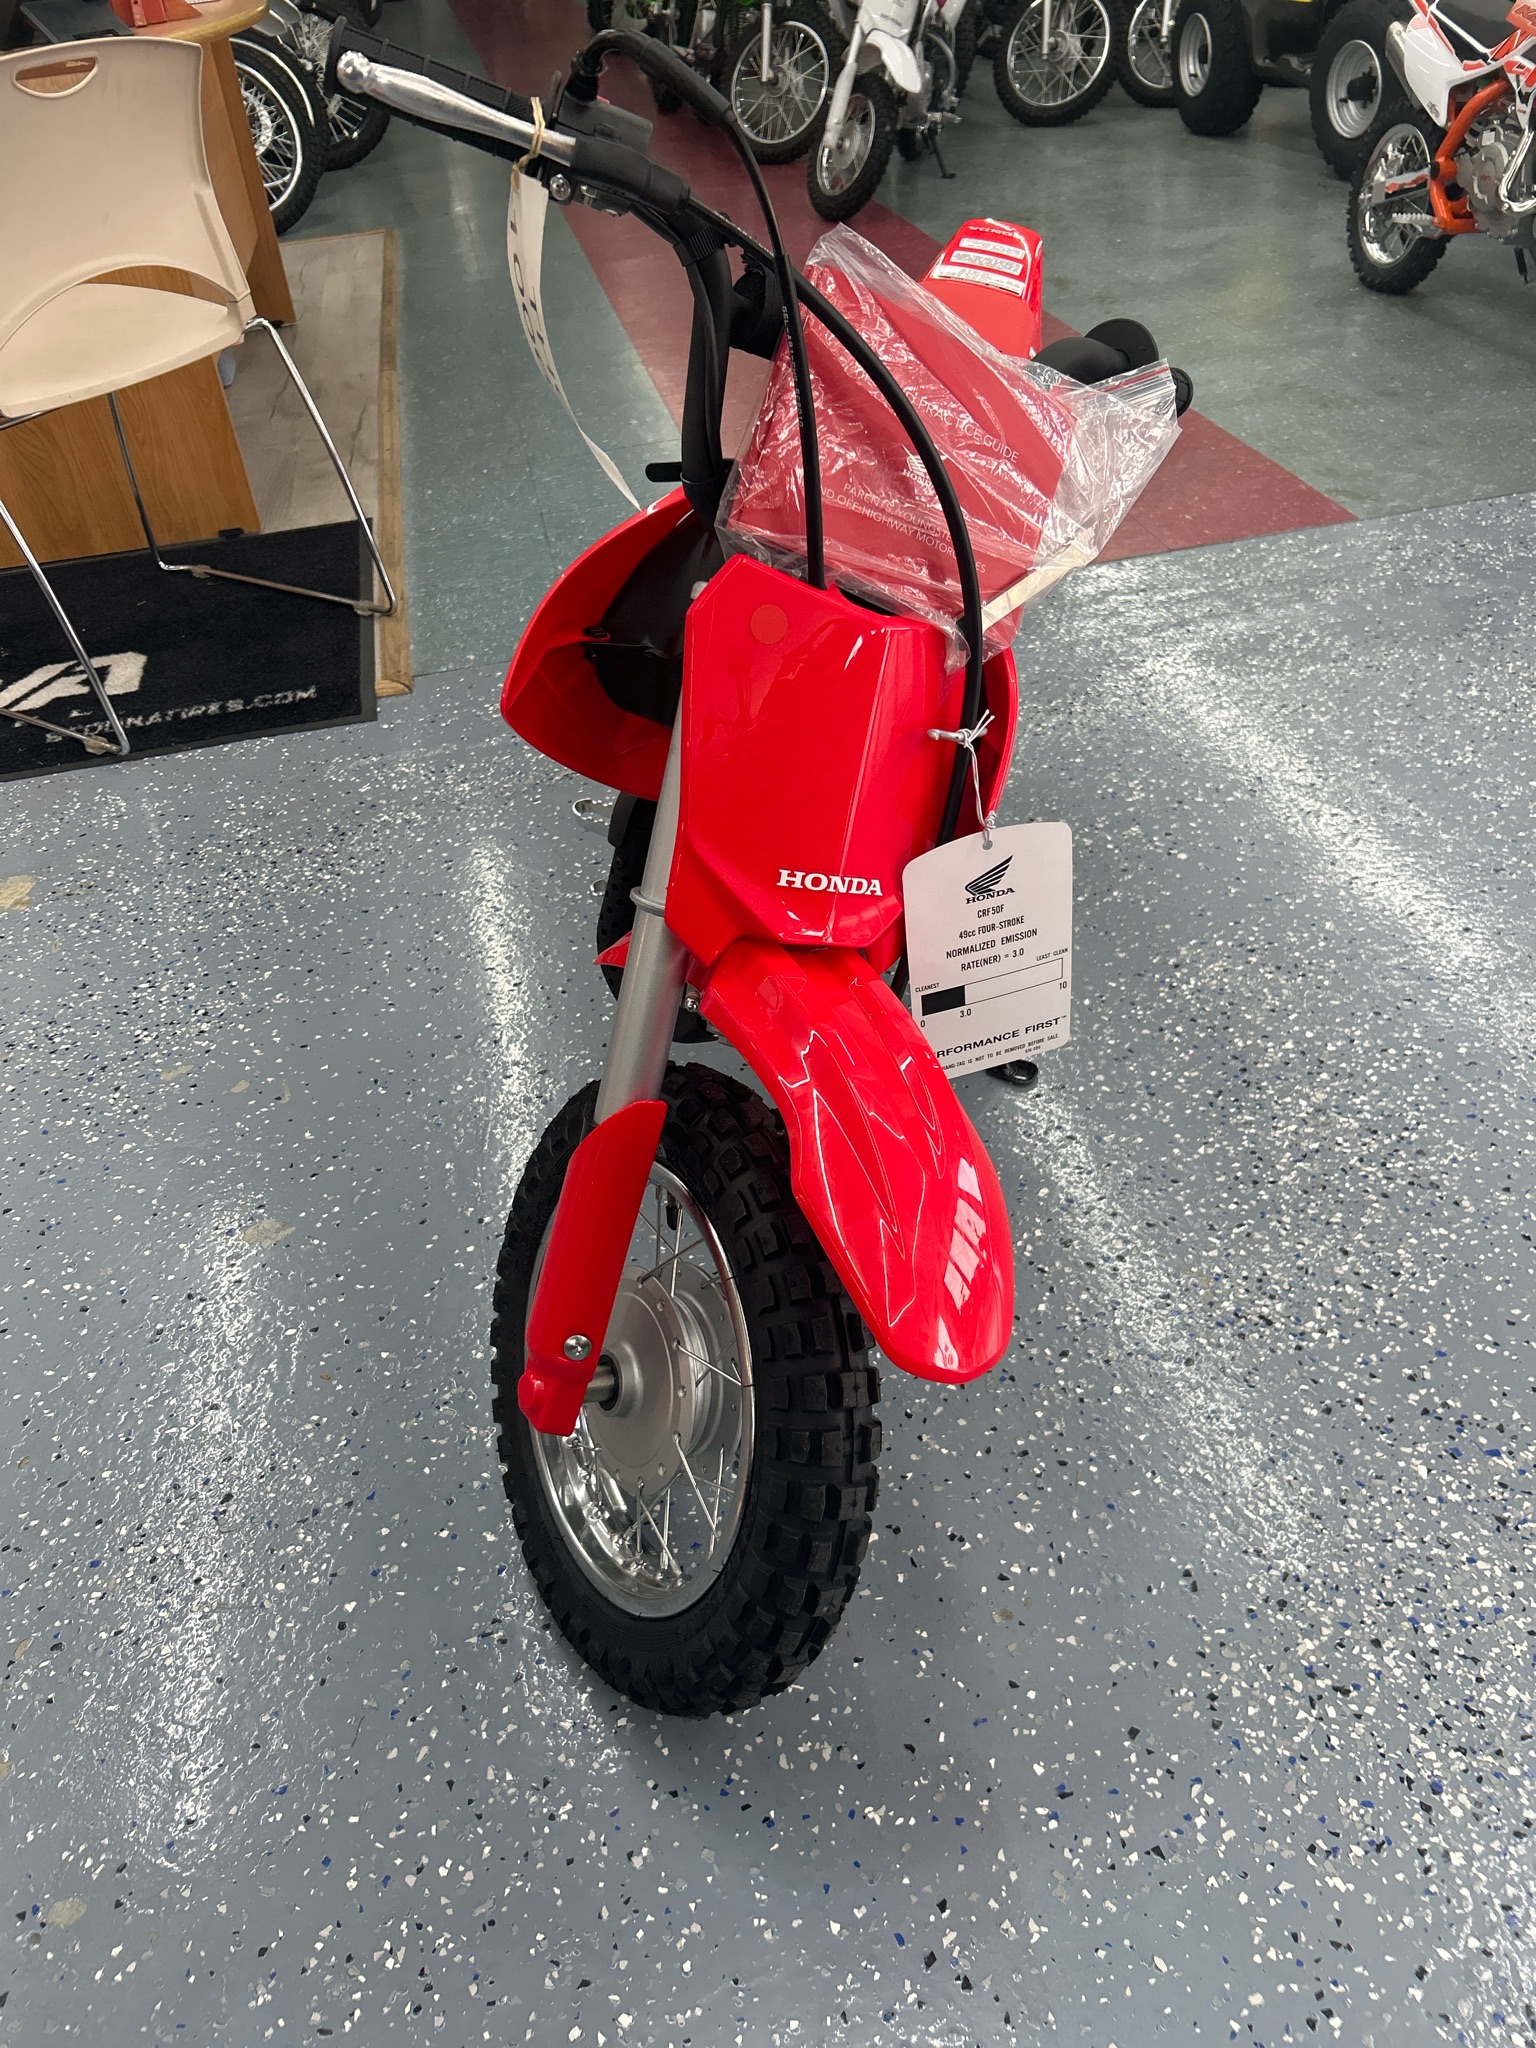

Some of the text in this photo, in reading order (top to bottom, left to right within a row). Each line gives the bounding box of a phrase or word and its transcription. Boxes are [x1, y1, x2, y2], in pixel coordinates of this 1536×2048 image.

[983, 434, 1020, 464] GUIDE
[895, 509, 953, 543] YOUNGSTE
[776, 868, 883, 897] HONDA
[965, 887, 1016, 905] HONDA
[958, 915, 1025, 940] 49cc FOUR-STROKE
[946, 928, 1038, 959] NORMALIZED EMISSION
[1036, 947, 1069, 962] LEAST CLEAN
[961, 954, 1002, 972] RATE(NER)
[1012, 947, 1025, 958] 3.0
[915, 982, 940, 994] CLEANEST
[1058, 981, 1068, 990] 10
[920, 1019, 926, 1028] 0
[959, 1008, 972, 1019] 3.0
[936, 1029, 1020, 1059] RFORMANCE
